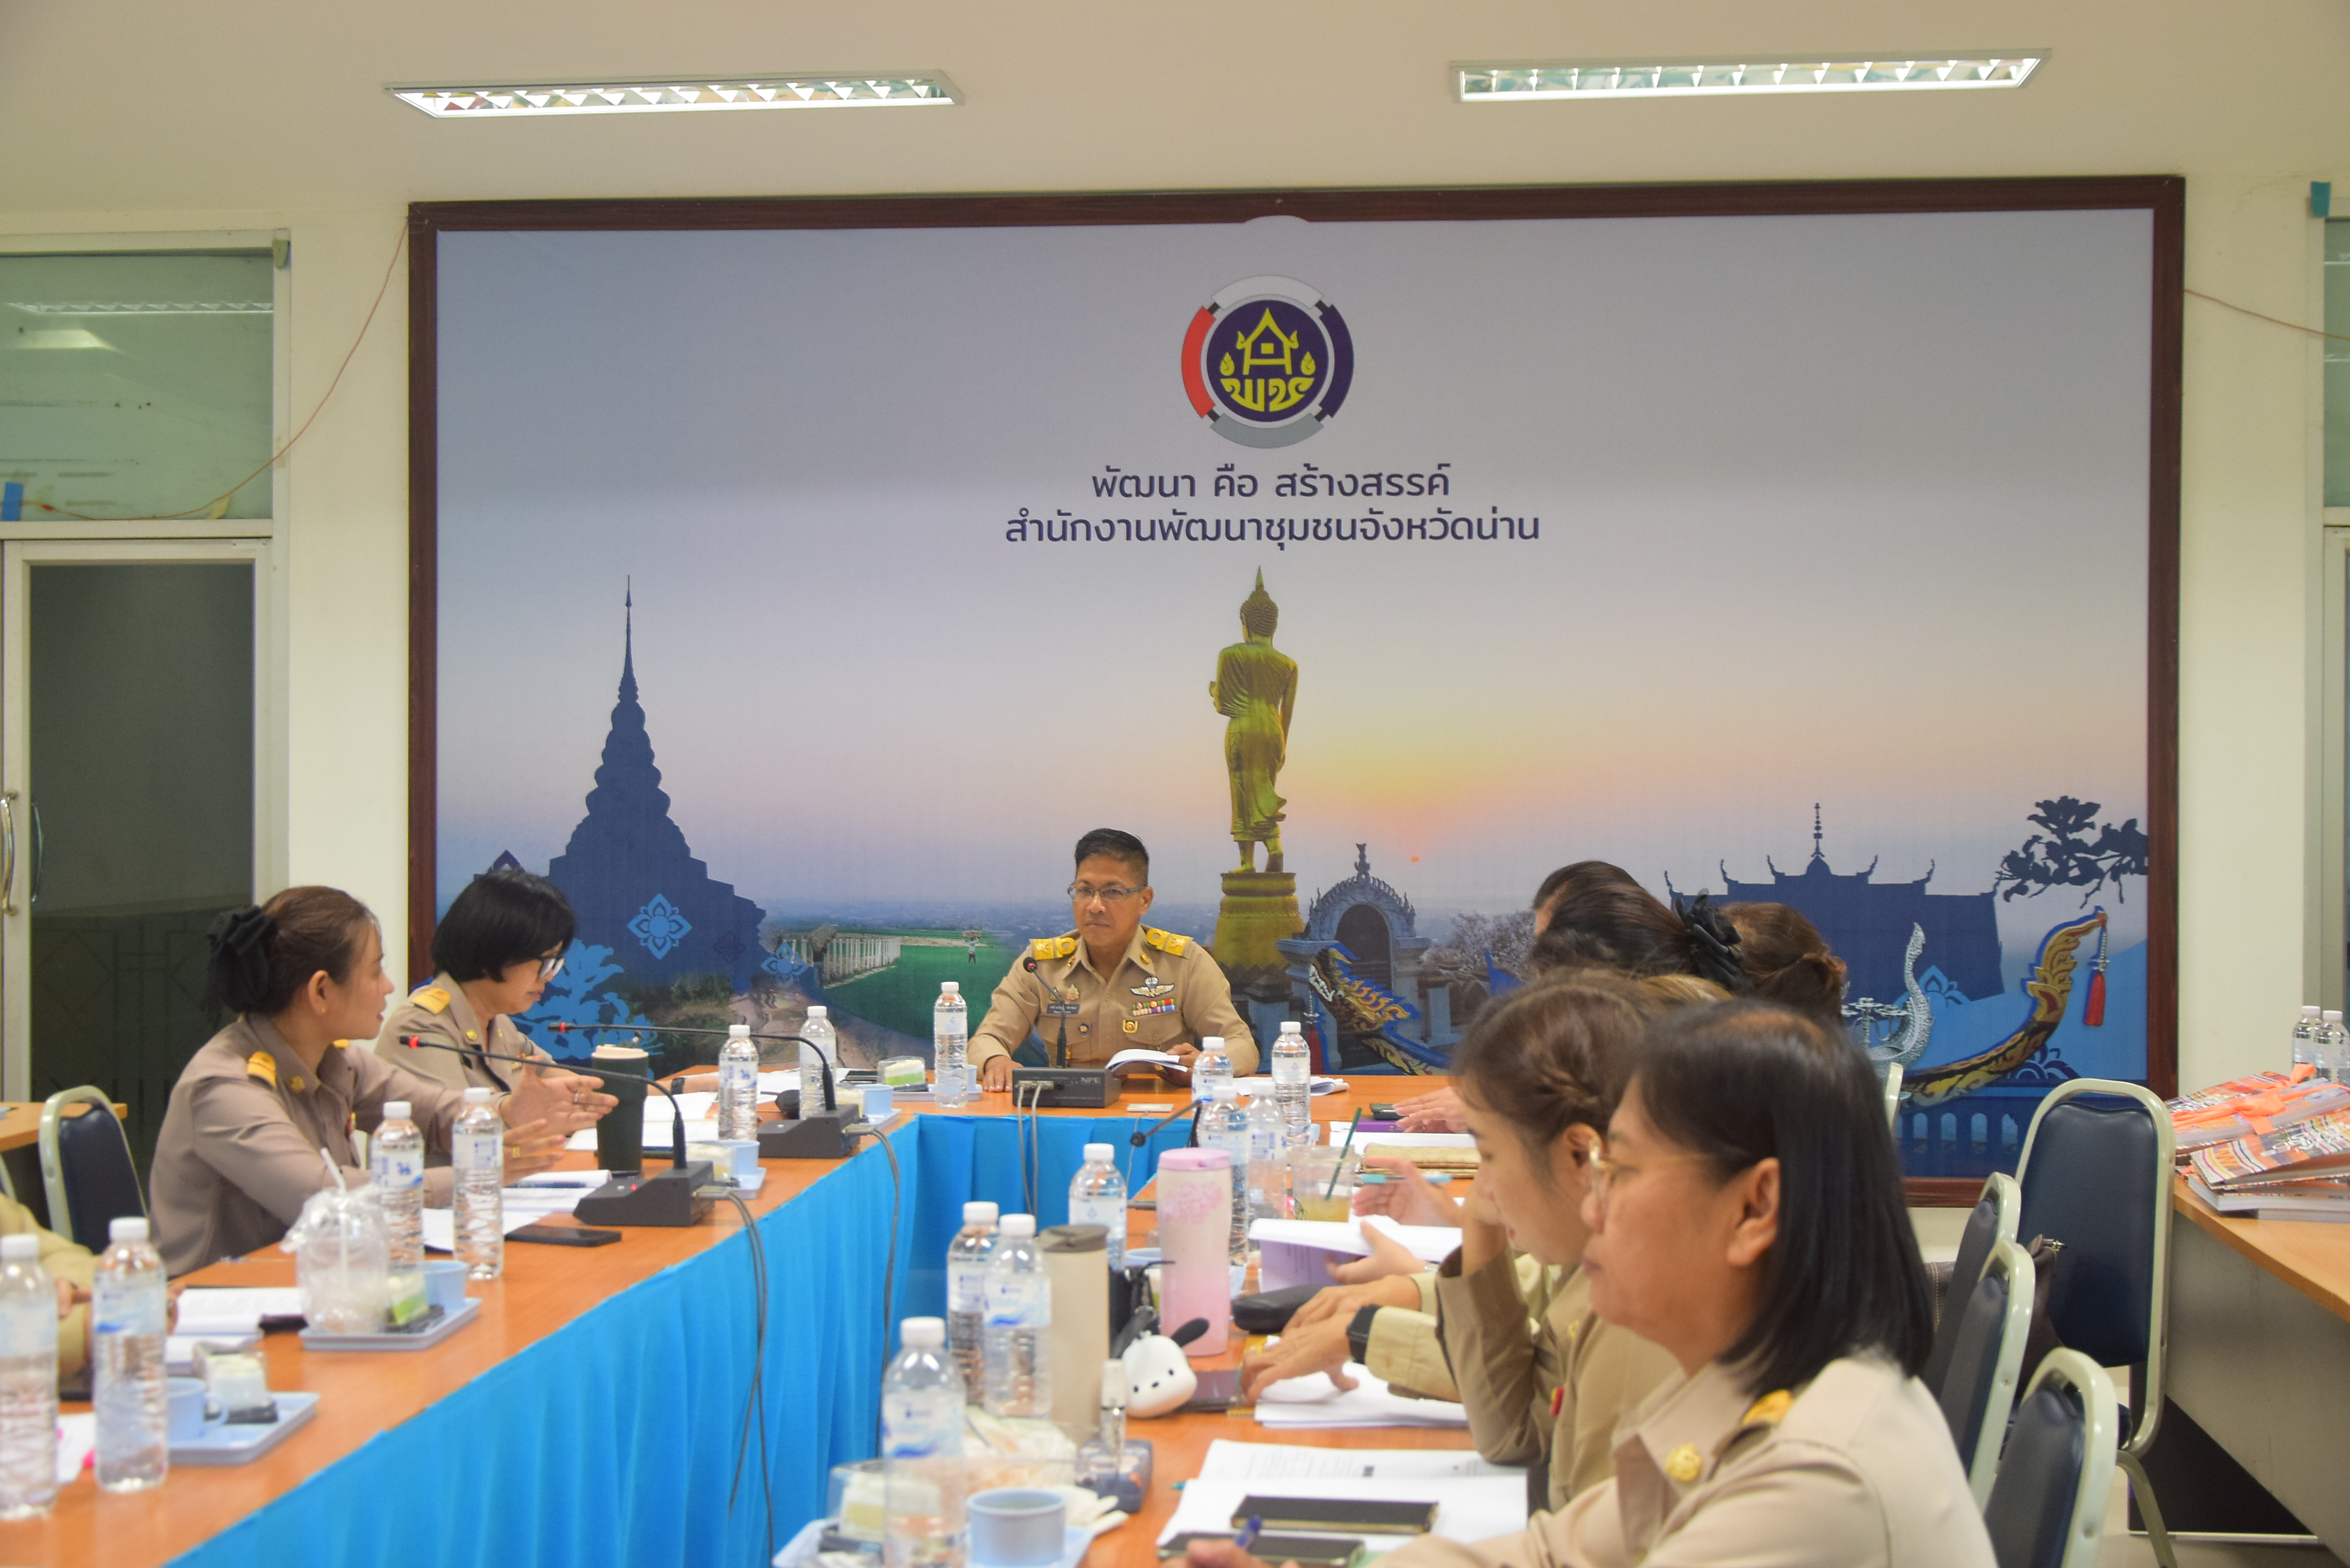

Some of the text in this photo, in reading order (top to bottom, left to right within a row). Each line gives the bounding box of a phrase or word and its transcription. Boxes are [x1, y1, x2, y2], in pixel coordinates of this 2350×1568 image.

[1092, 463, 1451, 498] พัฒนา คือ สร้างสรรค์
[1006, 506, 1539, 551] สำนักงานพัฒนาชุมชนจังหวัดน่าน
